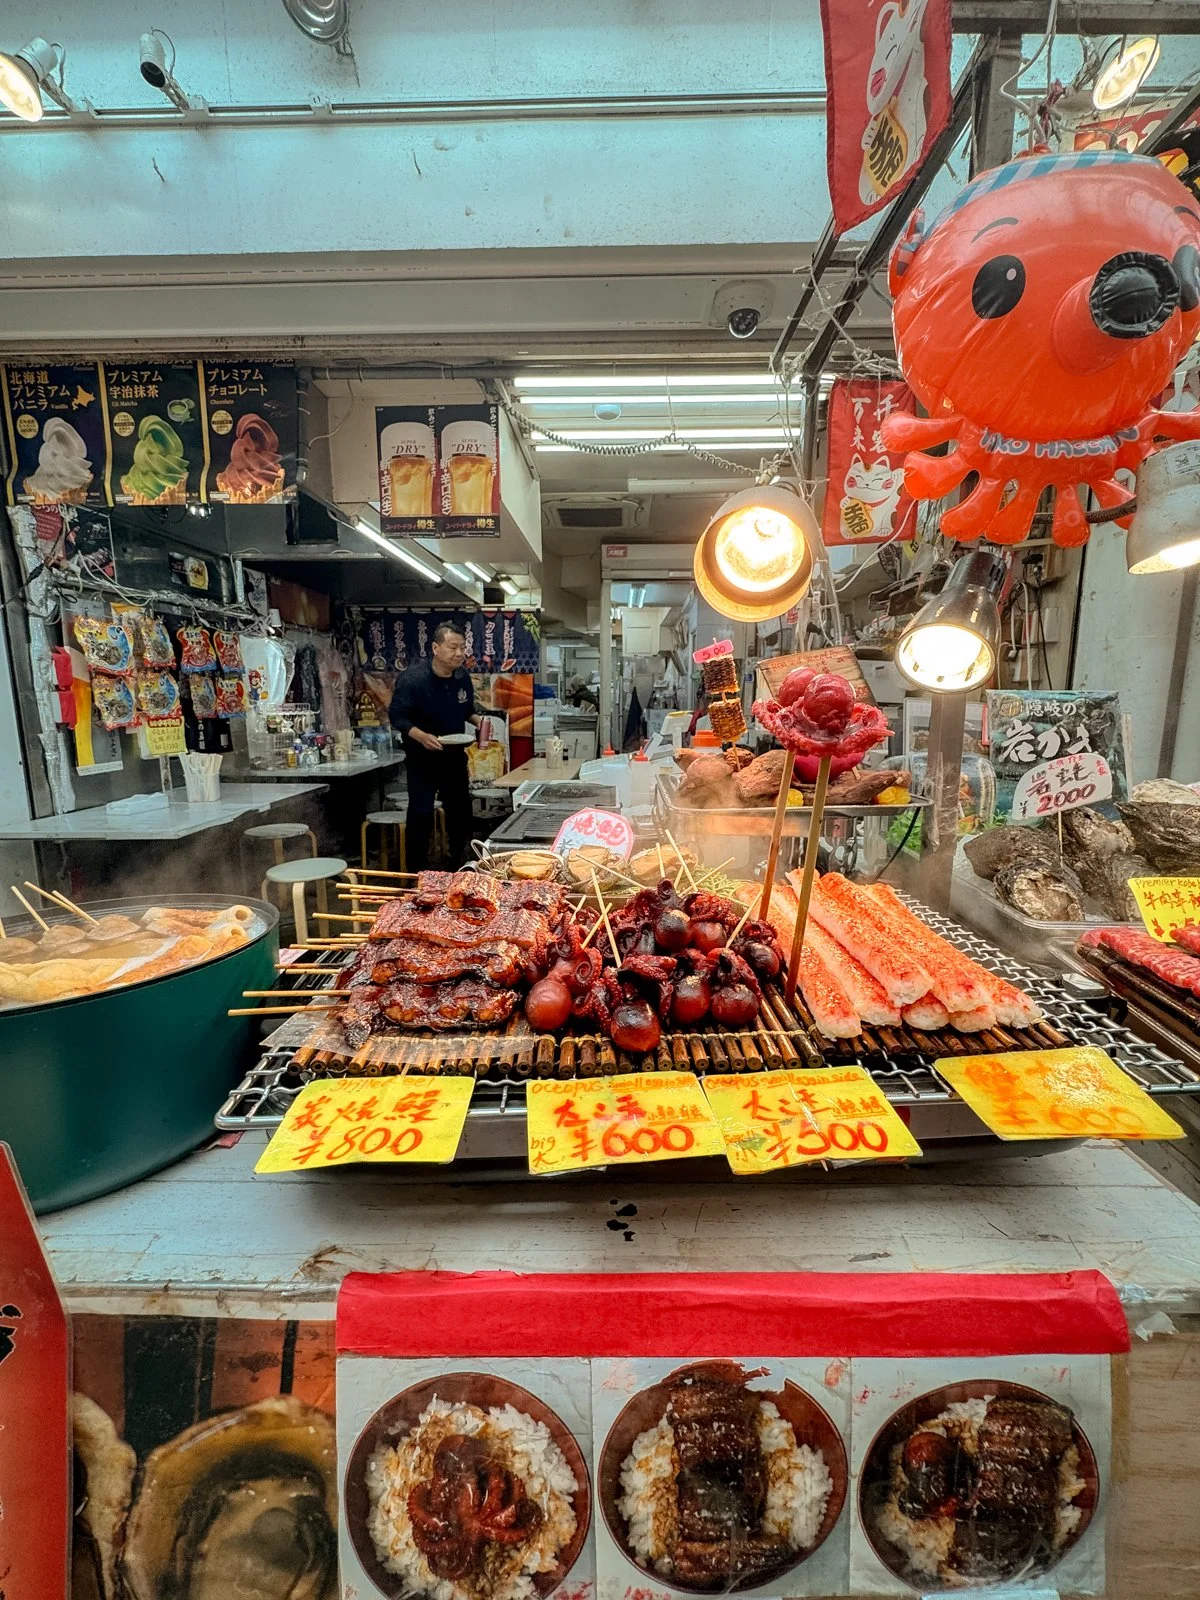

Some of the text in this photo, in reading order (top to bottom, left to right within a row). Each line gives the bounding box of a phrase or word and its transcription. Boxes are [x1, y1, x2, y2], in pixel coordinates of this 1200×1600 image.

[10, 370, 49, 385] 北海道
[108, 370, 163, 383] プレミアム
[207, 368, 264, 382] プレミアム
[11, 384, 70, 398] プレミアム
[109, 384, 159, 399] 宇治抹茶
[208, 384, 268, 397] チョコレート
[13, 398, 48, 411] バニラ
[1026, 699, 1077, 717] 隠岐の
[1036, 783, 1097, 815] 2000
[531, 1136, 556, 1153] big
